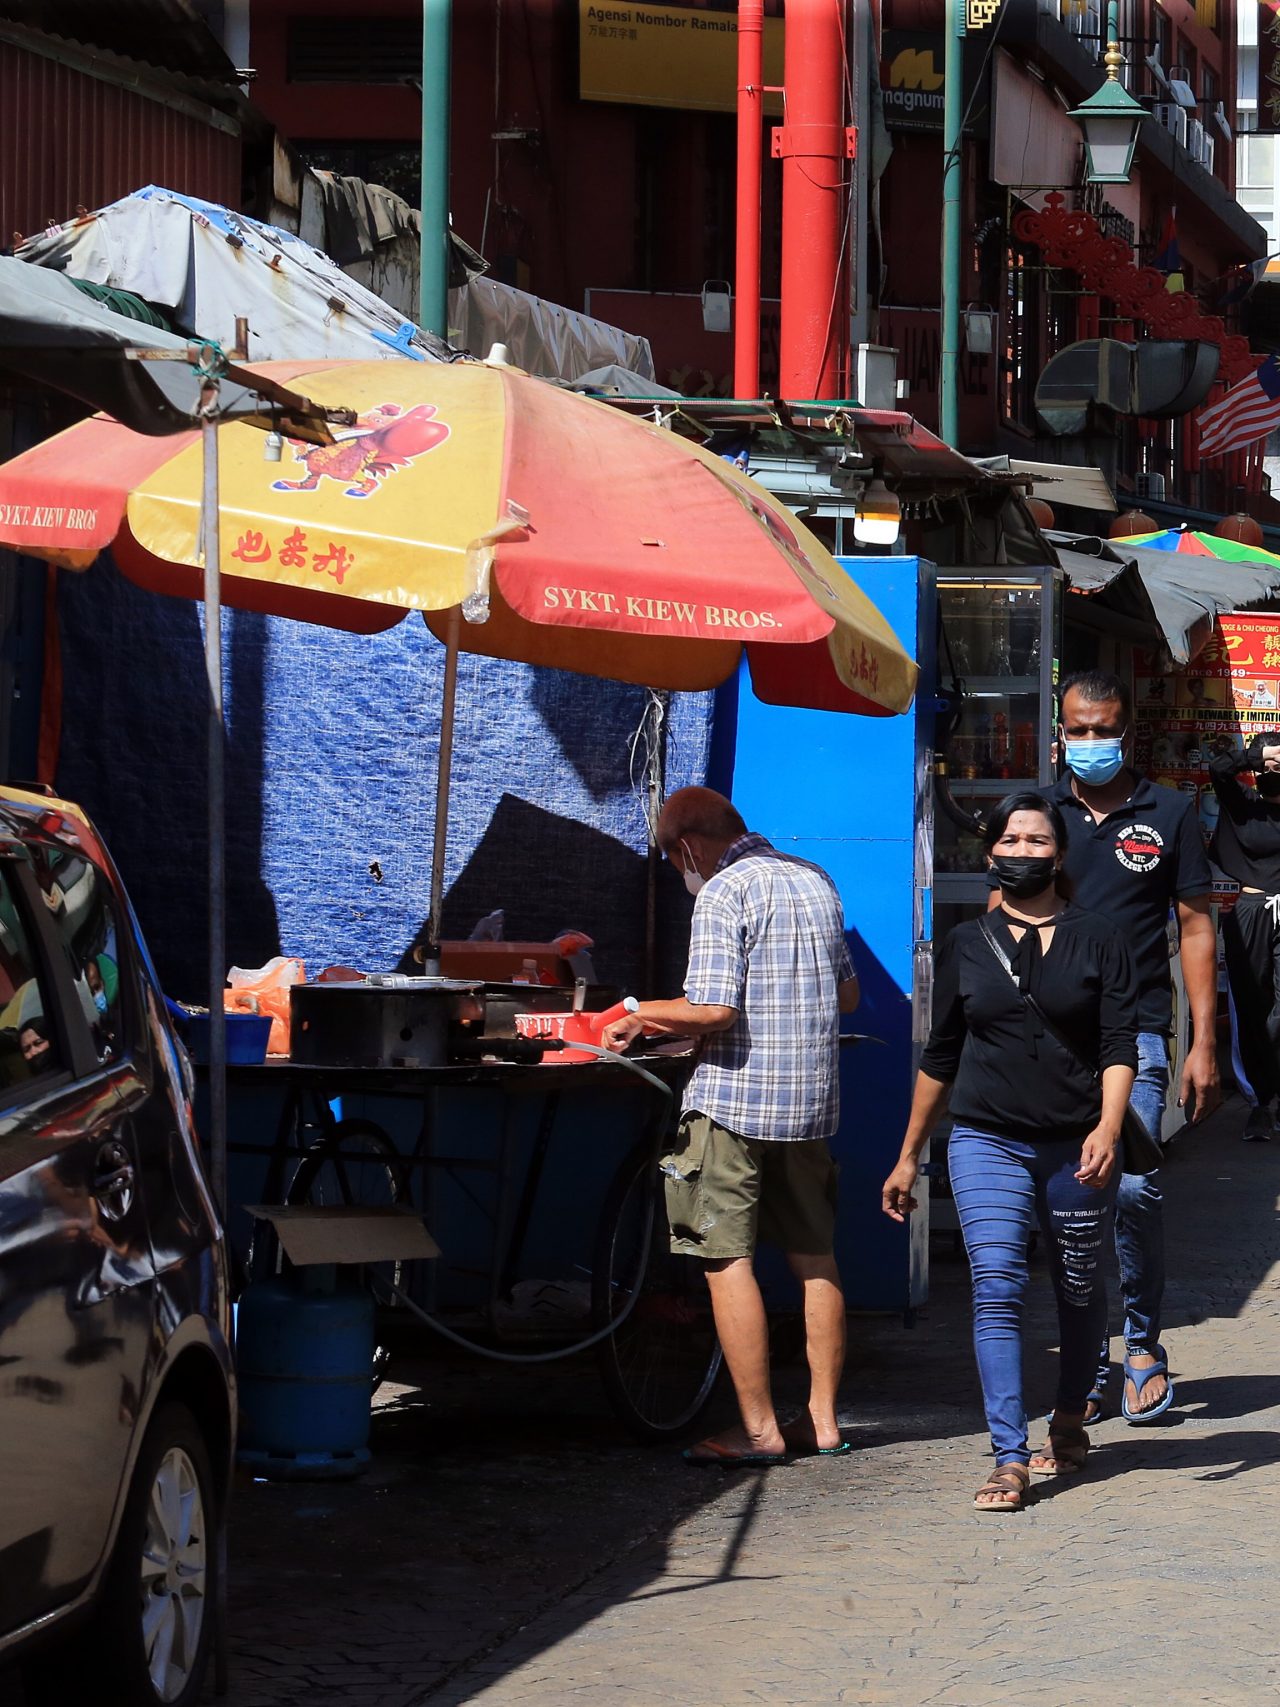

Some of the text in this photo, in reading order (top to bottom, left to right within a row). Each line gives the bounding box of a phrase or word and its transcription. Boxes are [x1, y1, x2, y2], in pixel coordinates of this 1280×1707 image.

[588, 6, 738, 32] Agensi Nombor Ramala
[32, 506, 67, 528] KIEW
[543, 586, 783, 629] SYKT. KIEW BROS.
[1217, 668, 1246, 677] 1949
[1199, 709, 1232, 719] BEWARE
[1234, 710, 1245, 720] OF
[1114, 848, 1143, 873] COLLEGE
[1132, 854, 1146, 863] NYC
